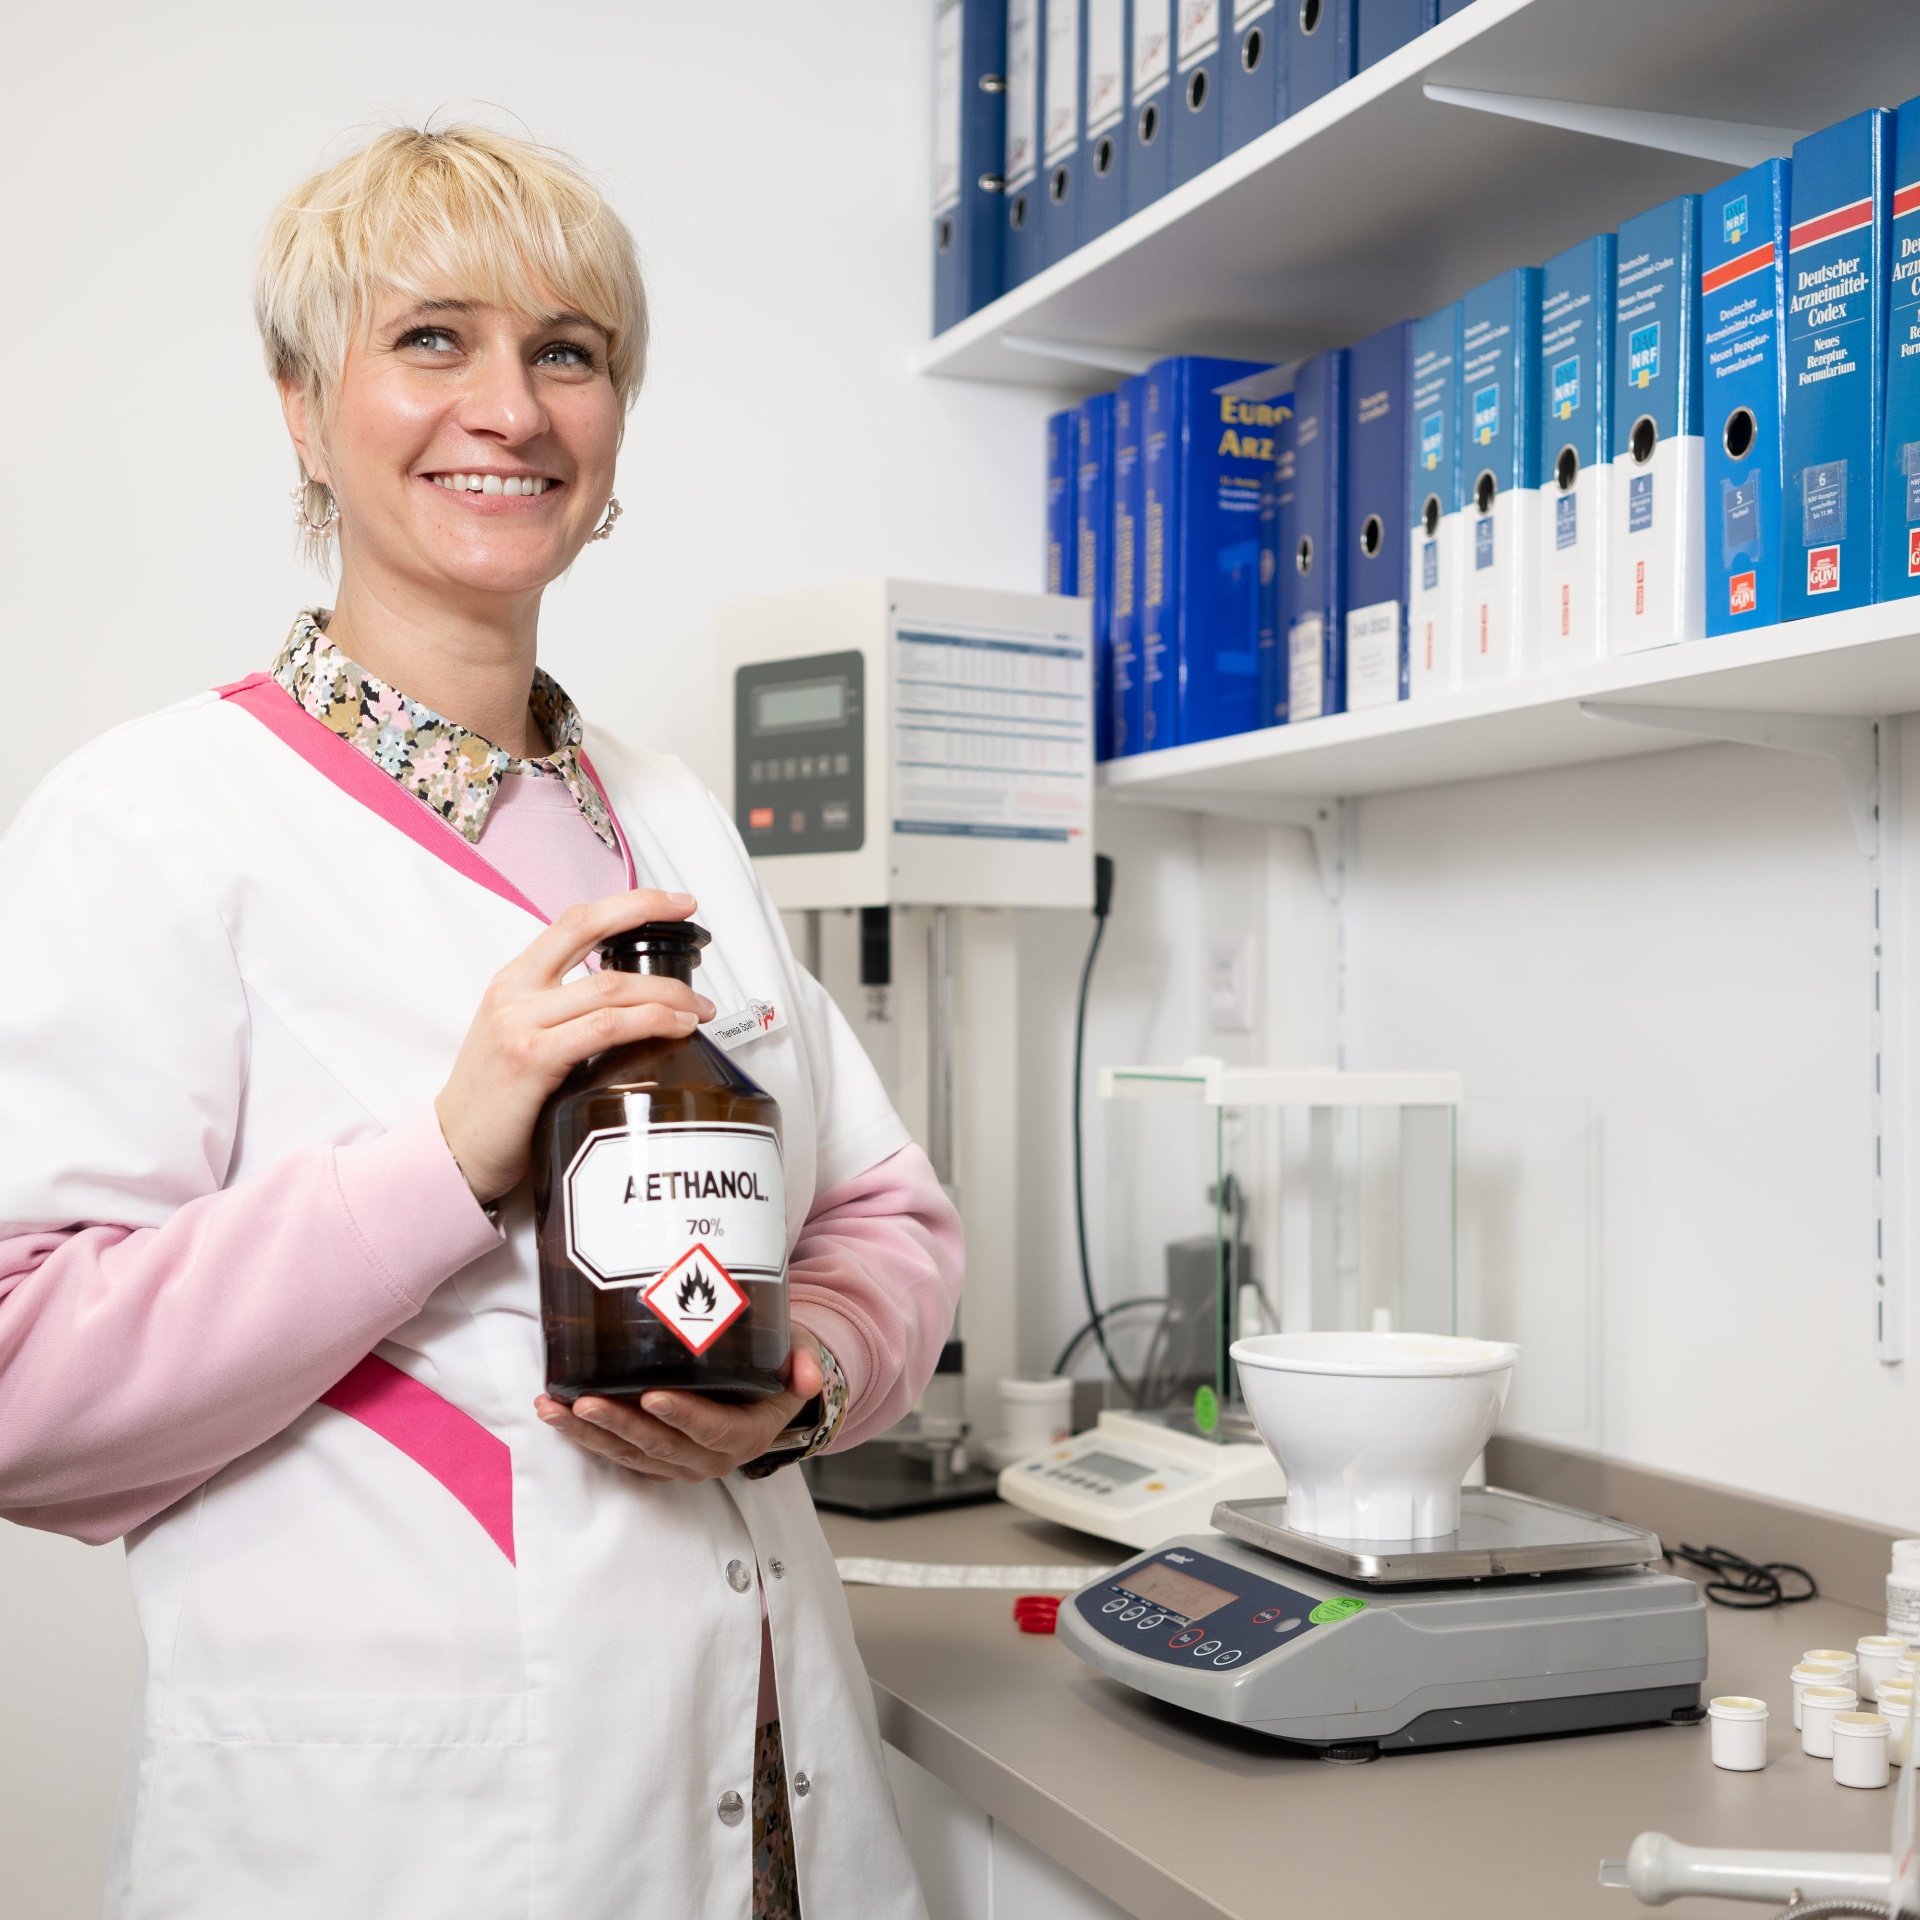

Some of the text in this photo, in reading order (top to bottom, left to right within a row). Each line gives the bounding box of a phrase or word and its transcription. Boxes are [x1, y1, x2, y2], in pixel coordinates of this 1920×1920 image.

[1725, 201, 1746, 221] DAC
[1725, 213, 1747, 232] NRF
[1798, 257, 1860, 291] Deutscher
[1789, 272, 1869, 314] Arzneimittel-
[1720, 298, 1757, 322] Deutscher
[1808, 303, 1847, 327] Codex
[1705, 308, 1774, 345] Arzneimittel-Codex
[1710, 334, 1770, 365] Neues Rezeptur-
[1814, 336, 1840, 352] Neues
[1631, 346, 1658, 370] NRF
[1716, 352, 1763, 379] Formularium
[1807, 348, 1848, 369] Rezeptur-
[1798, 361, 1856, 386] Formularium
[1554, 379, 1578, 402] NRF
[1637, 481, 1645, 493] 4
[1819, 472, 1827, 487] 6
[1736, 490, 1743, 505] 5
[624, 1170, 769, 1203] AETHANOL.
[686, 1218, 724, 1236] 70%
